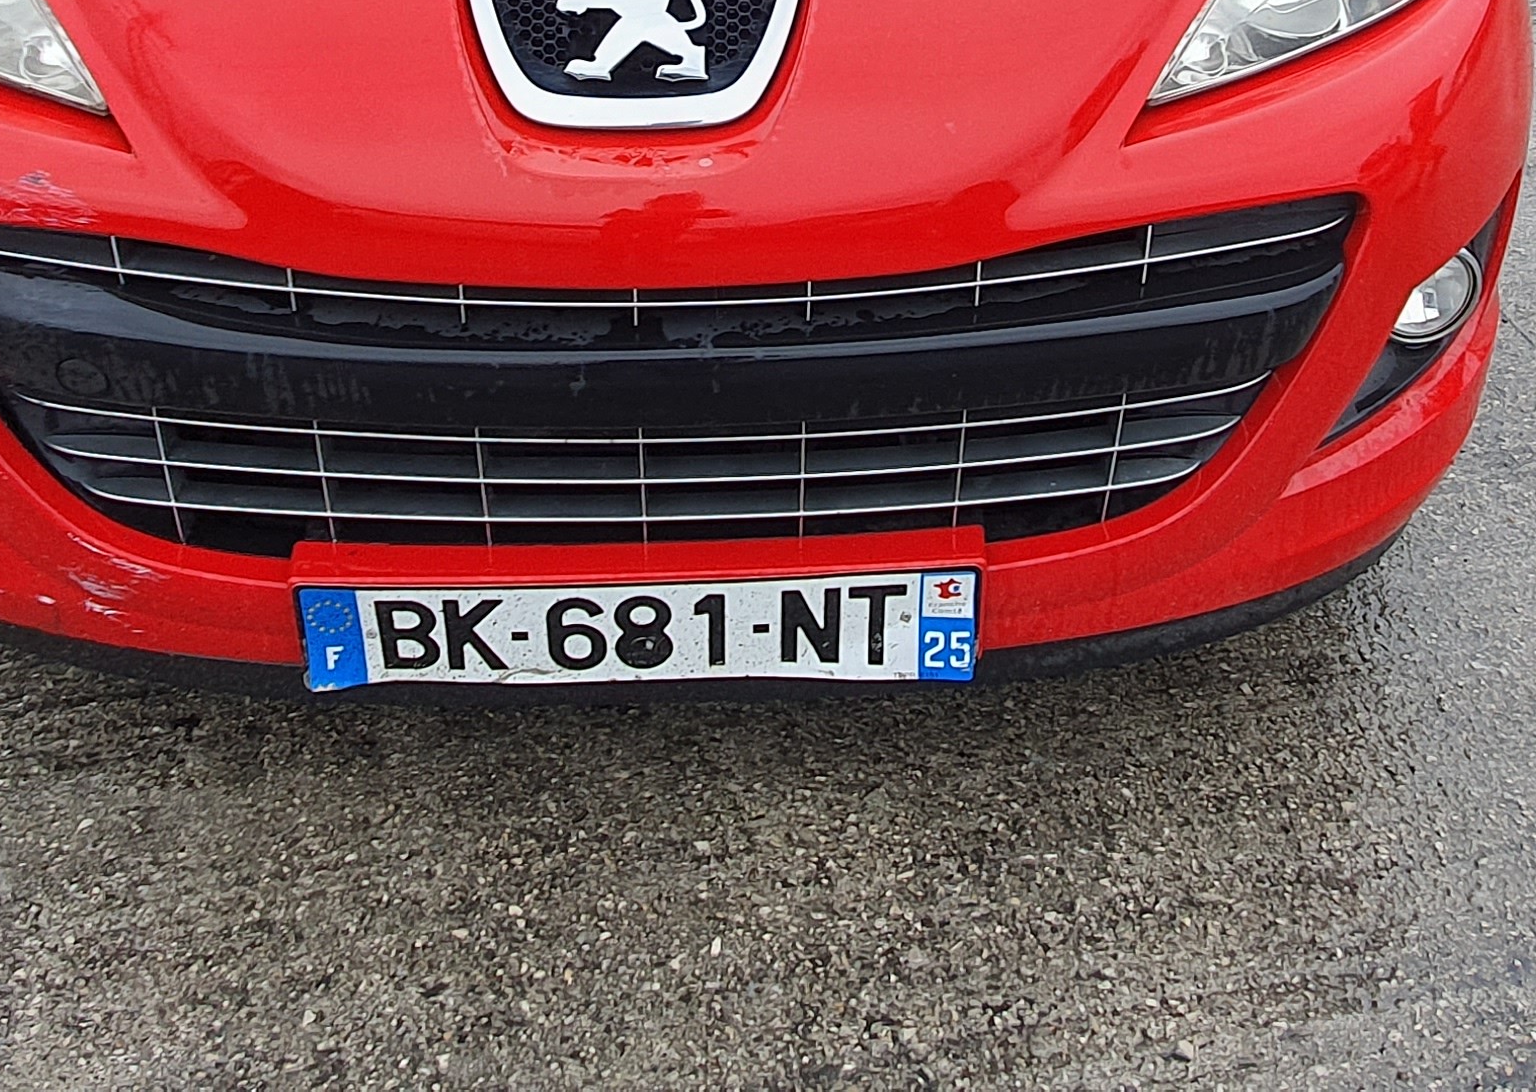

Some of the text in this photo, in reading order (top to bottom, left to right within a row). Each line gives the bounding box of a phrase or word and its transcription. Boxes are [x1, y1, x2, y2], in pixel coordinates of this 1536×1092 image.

[373, 584, 908, 670] BK-681-NT
[325, 645, 345, 670] F
[924, 630, 971, 668] 25
